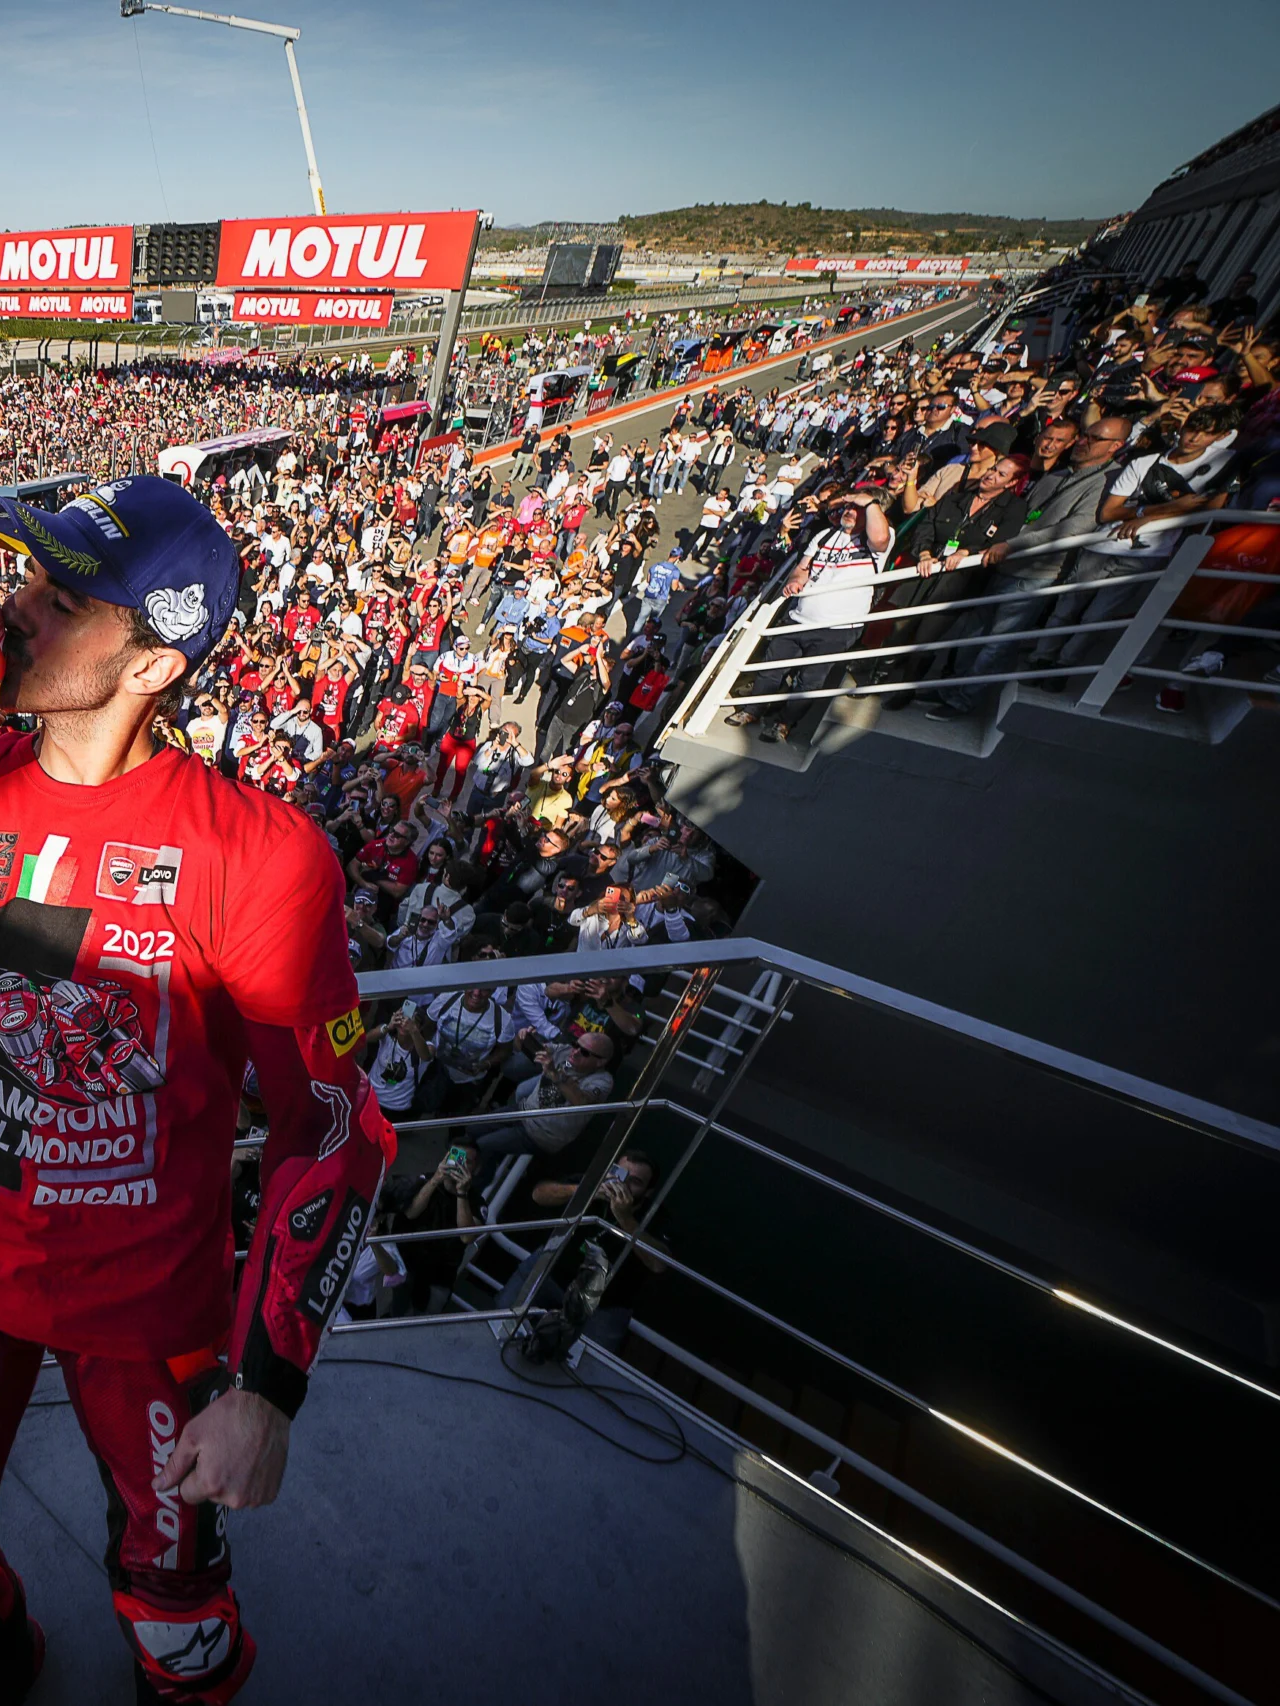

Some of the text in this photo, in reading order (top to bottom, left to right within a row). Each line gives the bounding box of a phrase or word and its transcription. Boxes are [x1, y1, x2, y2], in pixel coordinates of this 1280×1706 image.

[0, 236, 119, 281] MOTUL
[241, 224, 428, 278] MOTUL
[815, 259, 963, 271] MOTUL MOTUL MOTUL
[29, 296, 71, 312] MOTUL
[80, 296, 126, 313] MOTUL
[239, 297, 382, 320] MOTUL MOTUL
[590, 394, 609, 411] Lenovo
[102, 923, 176, 961] 2022
[14, 1130, 136, 1165] MONDO
[32, 1178, 158, 1206] DUCATI
[308, 1204, 363, 1316] Lenovo
